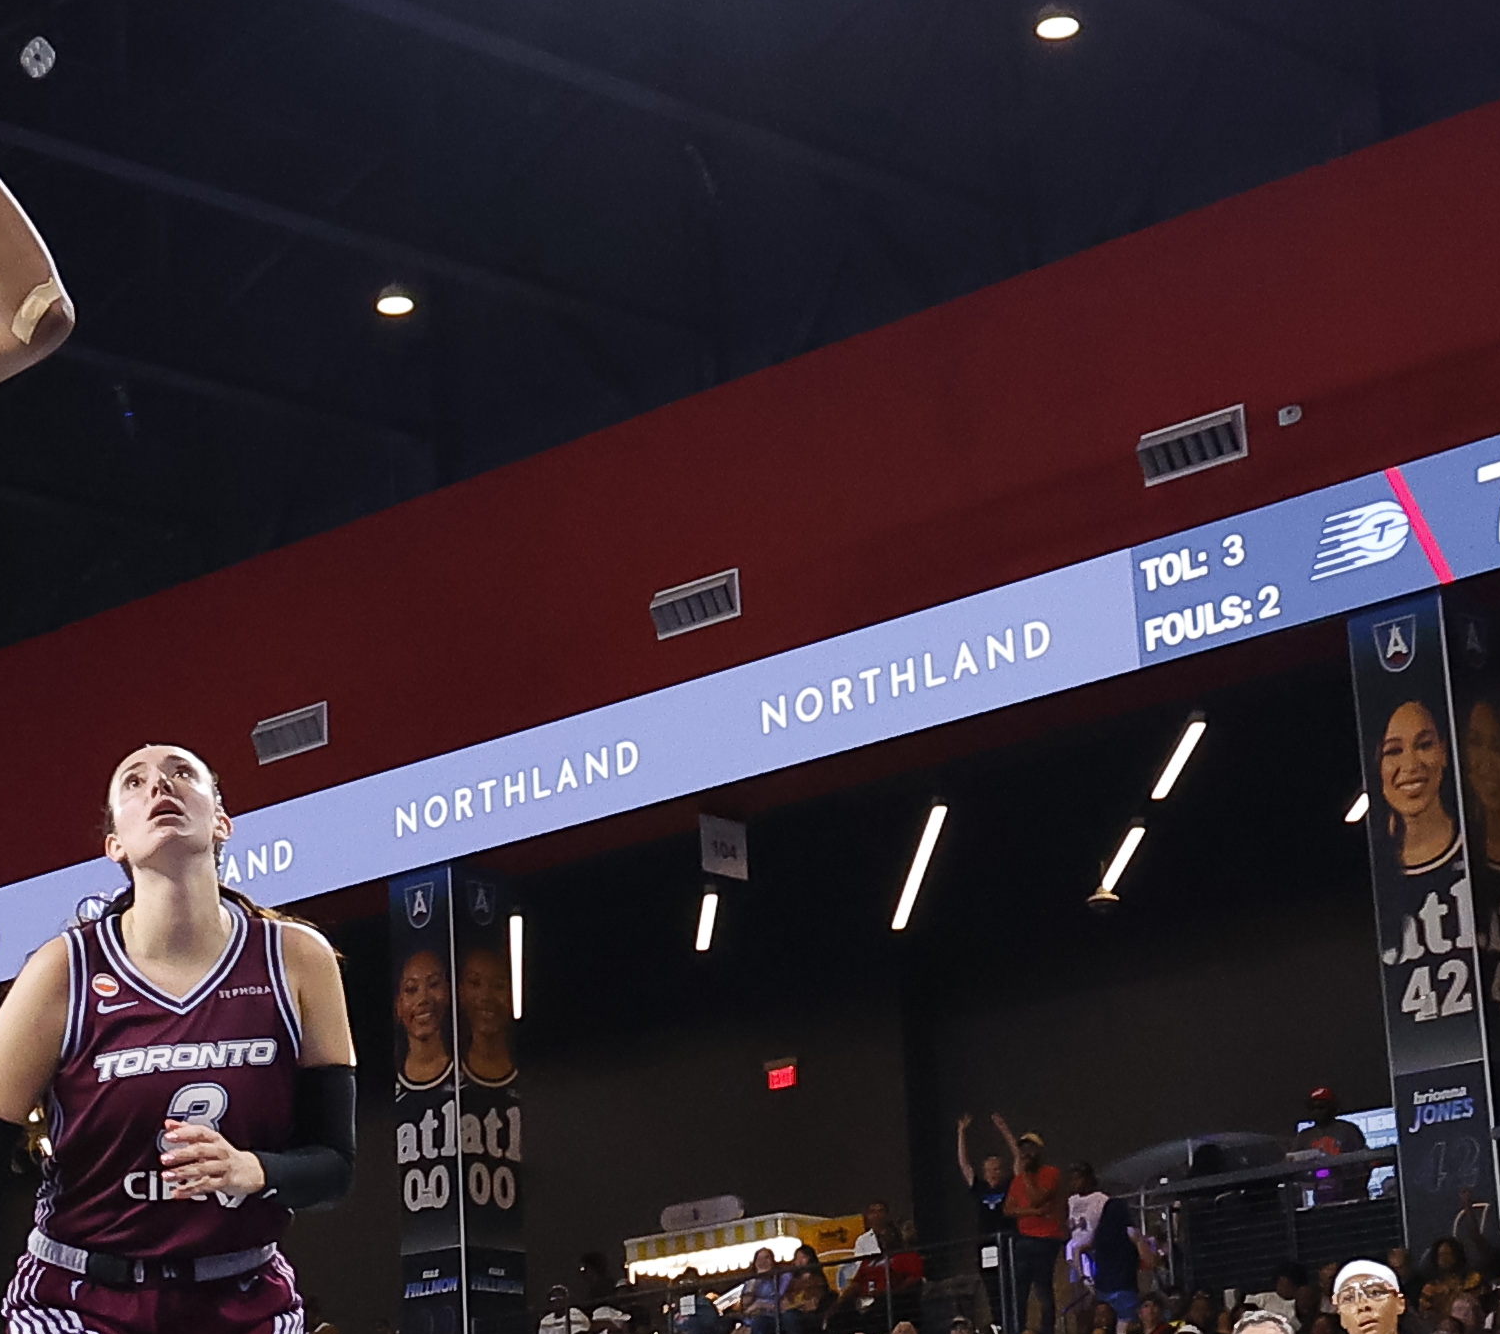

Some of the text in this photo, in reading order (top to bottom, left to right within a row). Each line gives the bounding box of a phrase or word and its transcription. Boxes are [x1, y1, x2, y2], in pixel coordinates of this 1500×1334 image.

[1139, 534, 1246, 592] TOL: 3
[1143, 584, 1282, 653] FOULS: 2
[760, 620, 1053, 735] NORTHLAND
[394, 739, 641, 839] NORTHLAND
[1401, 958, 1474, 1022] 42
[93, 1038, 278, 1083] TORONTO
[396, 1100, 457, 1164] atl
[461, 1106, 522, 1162] atl
[1408, 1097, 1475, 1134] JONES
[403, 1164, 450, 1212] 00
[468, 1161, 516, 1210] 00
